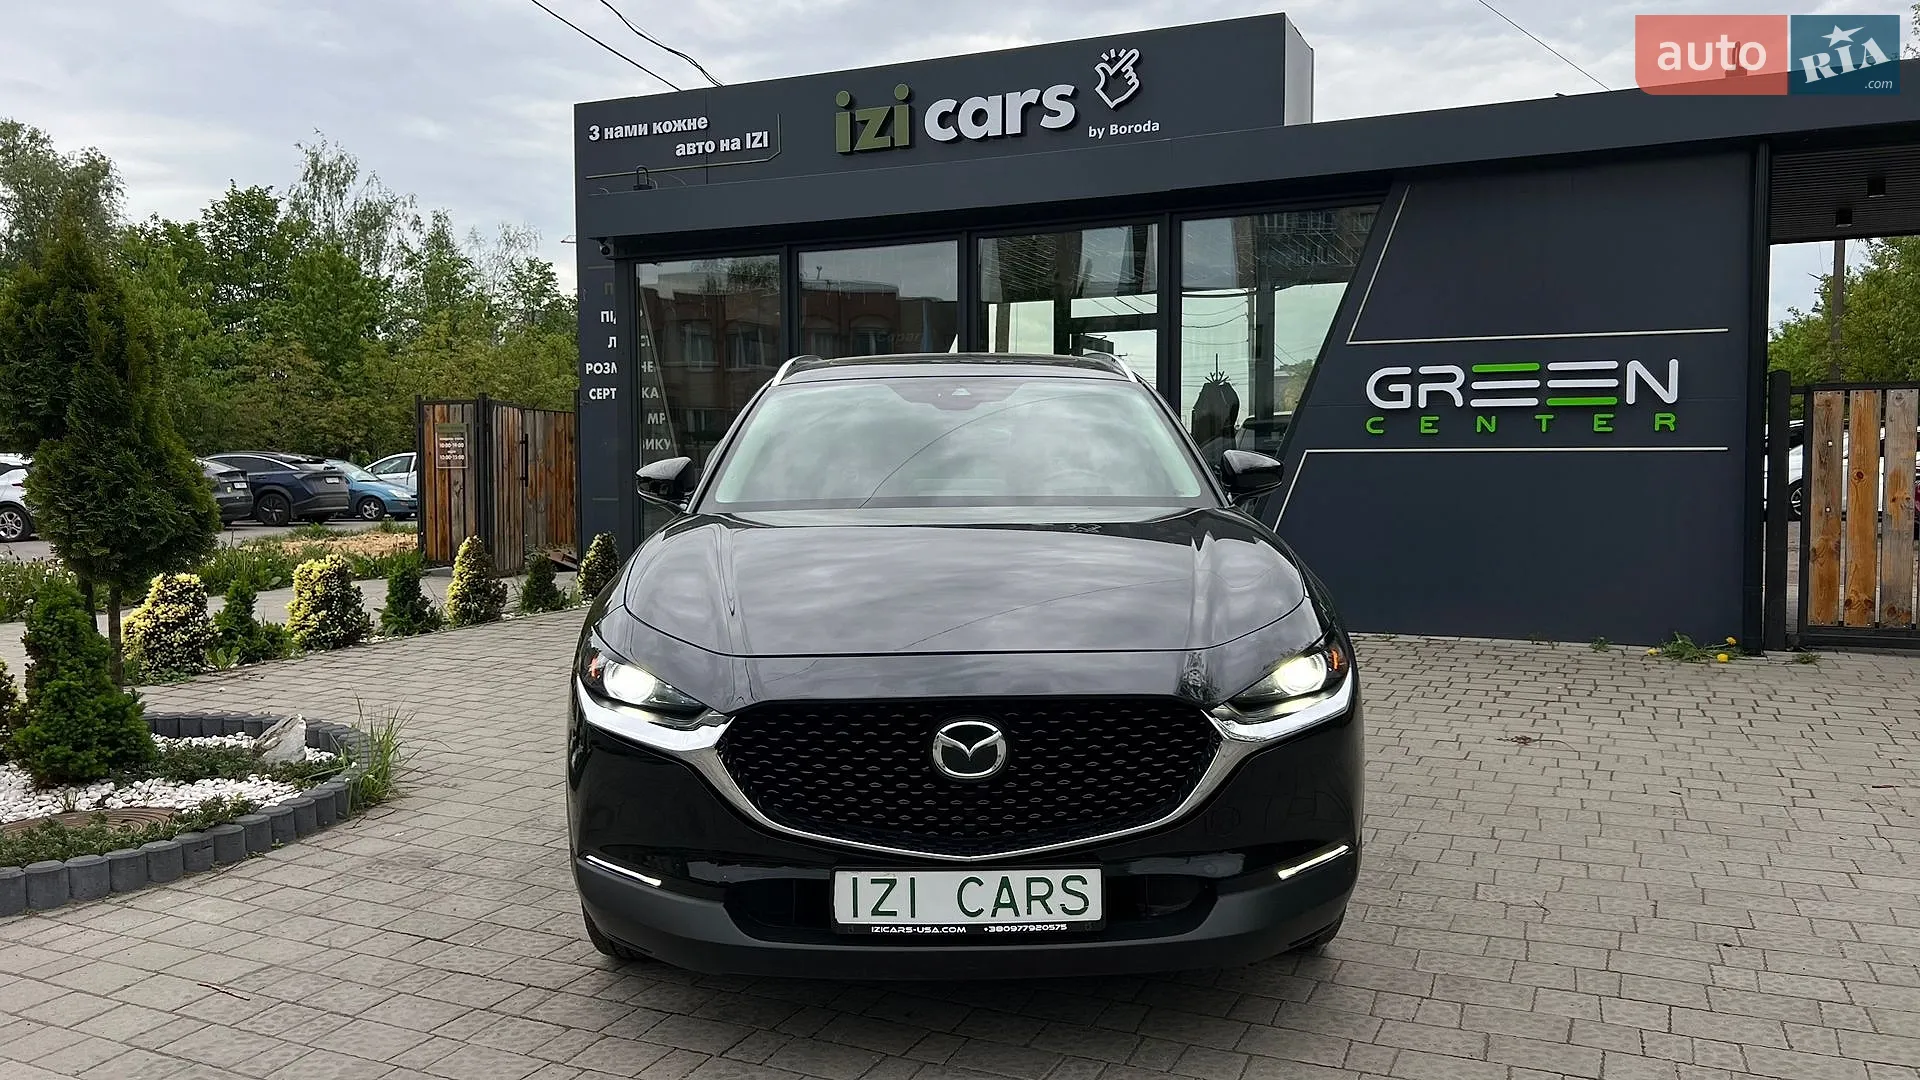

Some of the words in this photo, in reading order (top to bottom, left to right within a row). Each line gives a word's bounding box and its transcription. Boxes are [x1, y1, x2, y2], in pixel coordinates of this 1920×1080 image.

[603, 123, 648, 140] нами
[652, 116, 708, 135] кожне
[835, 83, 910, 153] izi
[924, 84, 1076, 142] cars
[1088, 125, 1105, 139] by
[1109, 120, 1161, 135] Boroda
[675, 140, 716, 157] авто
[719, 137, 741, 152] на
[745, 131, 769, 149] IZI
[1366, 358, 1679, 409] GREEN
[1365, 412, 1677, 434] CENTER
[851, 877, 916, 919] IZI
[956, 874, 1090, 919] CARS
[871, 926, 967, 934] IZICARS-USA.COM
[983, 923, 1068, 933] +380977920575
